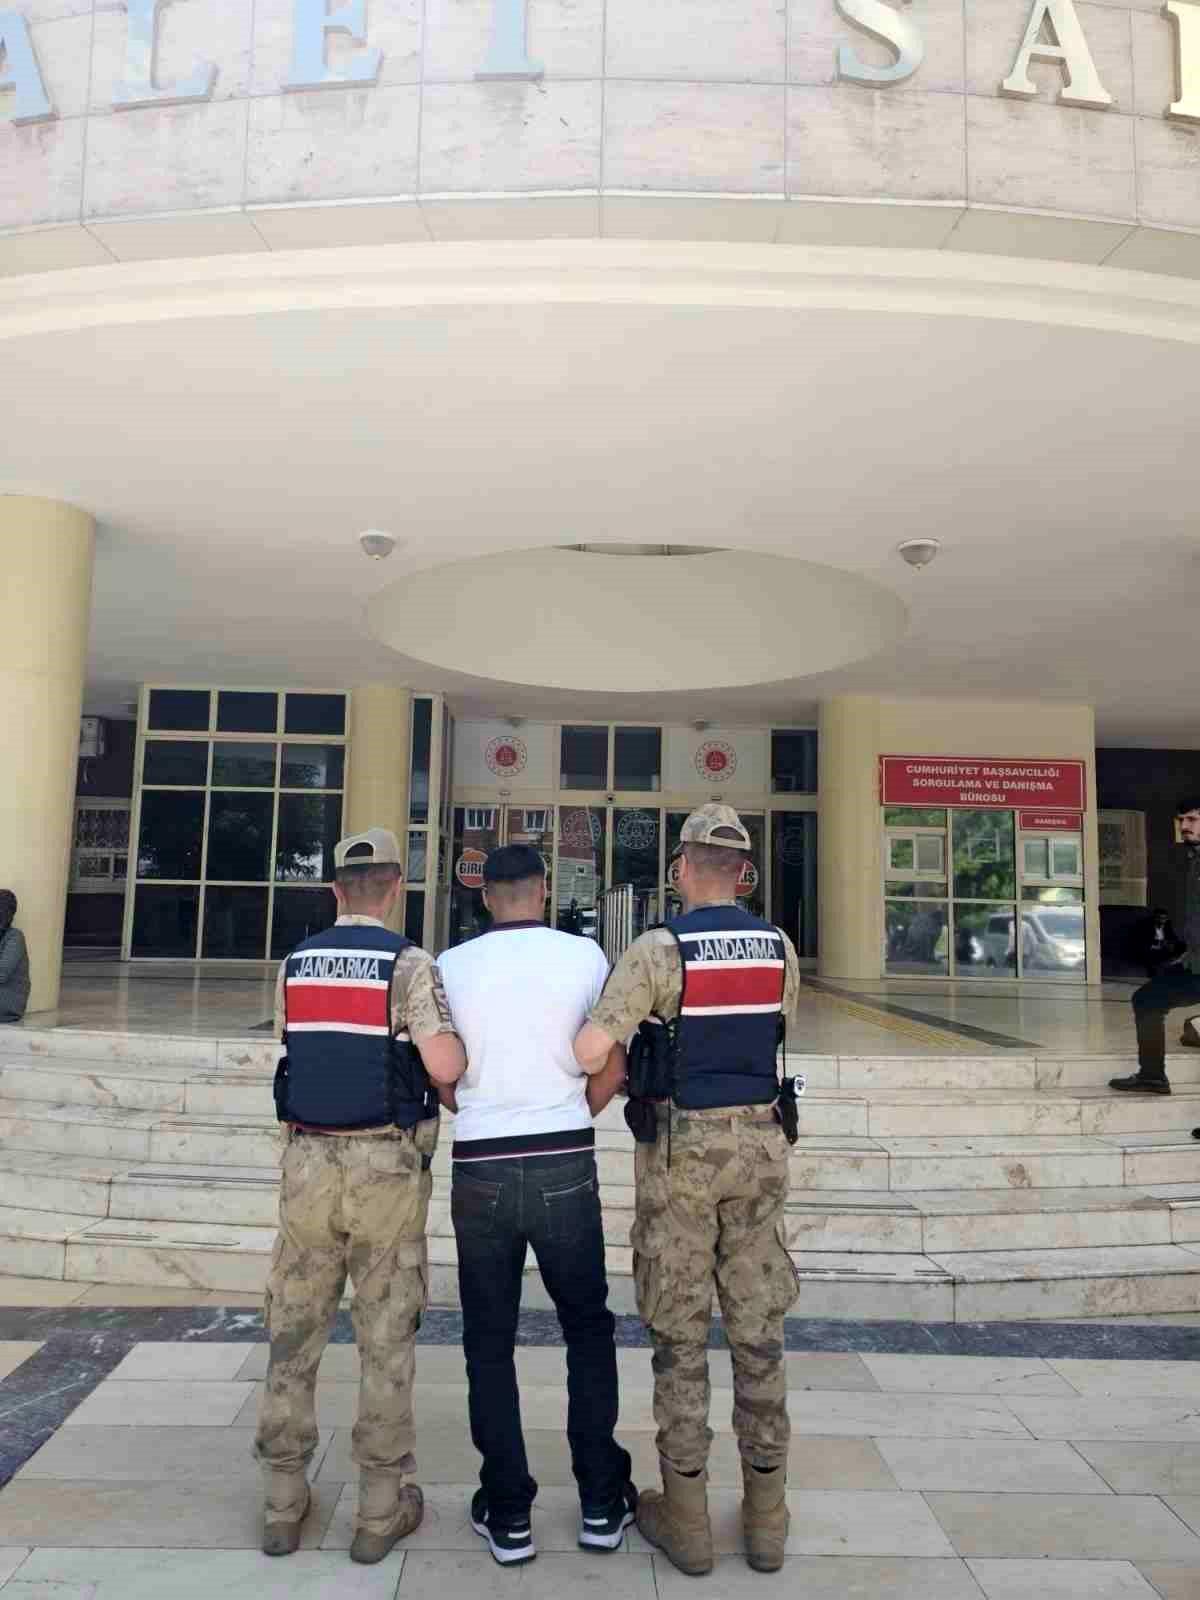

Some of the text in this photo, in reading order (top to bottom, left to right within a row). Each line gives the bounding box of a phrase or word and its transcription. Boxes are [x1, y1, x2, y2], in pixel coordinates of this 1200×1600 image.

[836, 0, 1200, 123] SA
[906, 764, 980, 777] CUMHURİYET
[912, 778, 1054, 793] SORGULAMA VE DANIŞMA
[960, 791, 1007, 803] BÜROSU
[694, 937, 777, 961] JANDARMA
[295, 955, 380, 980] JANDARMA
